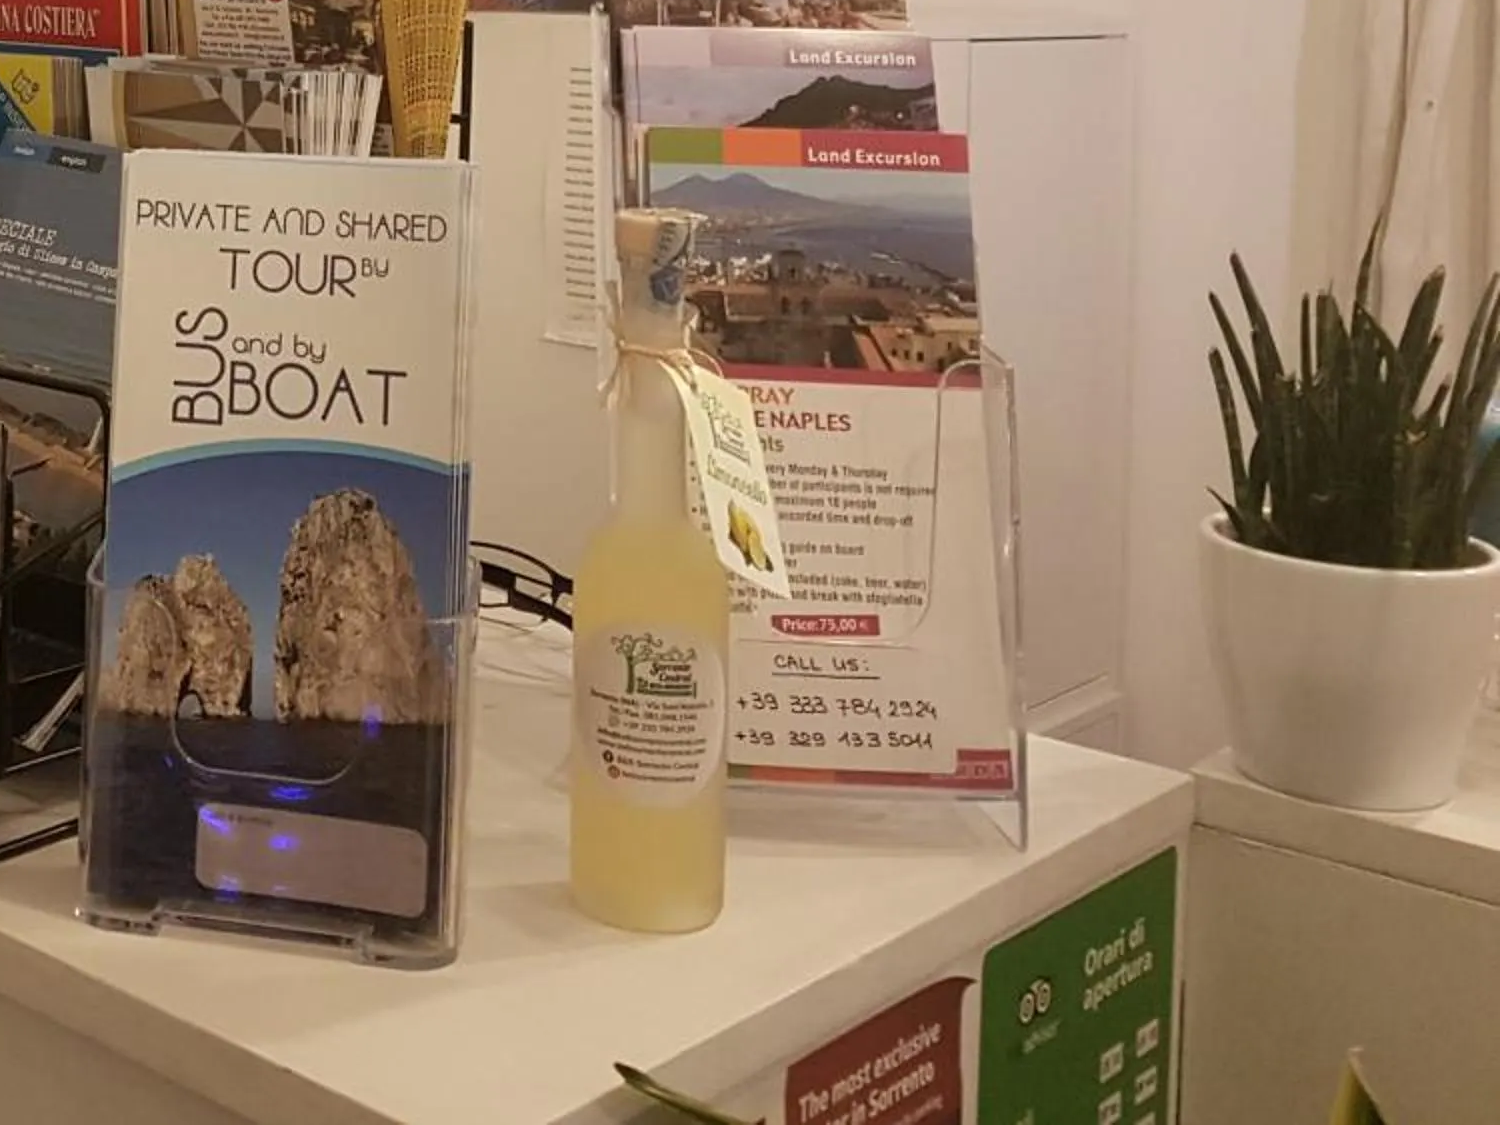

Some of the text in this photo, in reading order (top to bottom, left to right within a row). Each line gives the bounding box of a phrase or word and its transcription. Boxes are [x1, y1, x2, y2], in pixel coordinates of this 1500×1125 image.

[790, 49, 917, 67] Land Excursion
[808, 147, 941, 167] Land Excursion
[136, 198, 447, 243] PRIVATE AND SHARED
[219, 247, 356, 298] TOUR
[232, 333, 327, 363] and by
[172, 306, 229, 426] BUS
[228, 360, 408, 427] BOAT
[738, 386, 794, 405] RAY
[770, 410, 851, 432] NAPLES
[788, 463, 827, 479] Monday
[842, 466, 888, 481] Thursday
[802, 481, 861, 494] participants
[875, 484, 892, 494] not
[843, 498, 876, 511] people
[835, 544, 865, 556] board
[810, 590, 839, 602] break
[841, 592, 863, 603] with
[773, 654, 822, 672] CALL
[736, 691, 938, 721] +39 333 784 2924
[734, 728, 933, 750] +39 329 133 5011
[1084, 917, 1146, 976] Orari di
[1083, 951, 1154, 1011] apertura
[798, 1022, 941, 1123] The most exclusive
[868, 1061, 936, 1118] Sorrento
